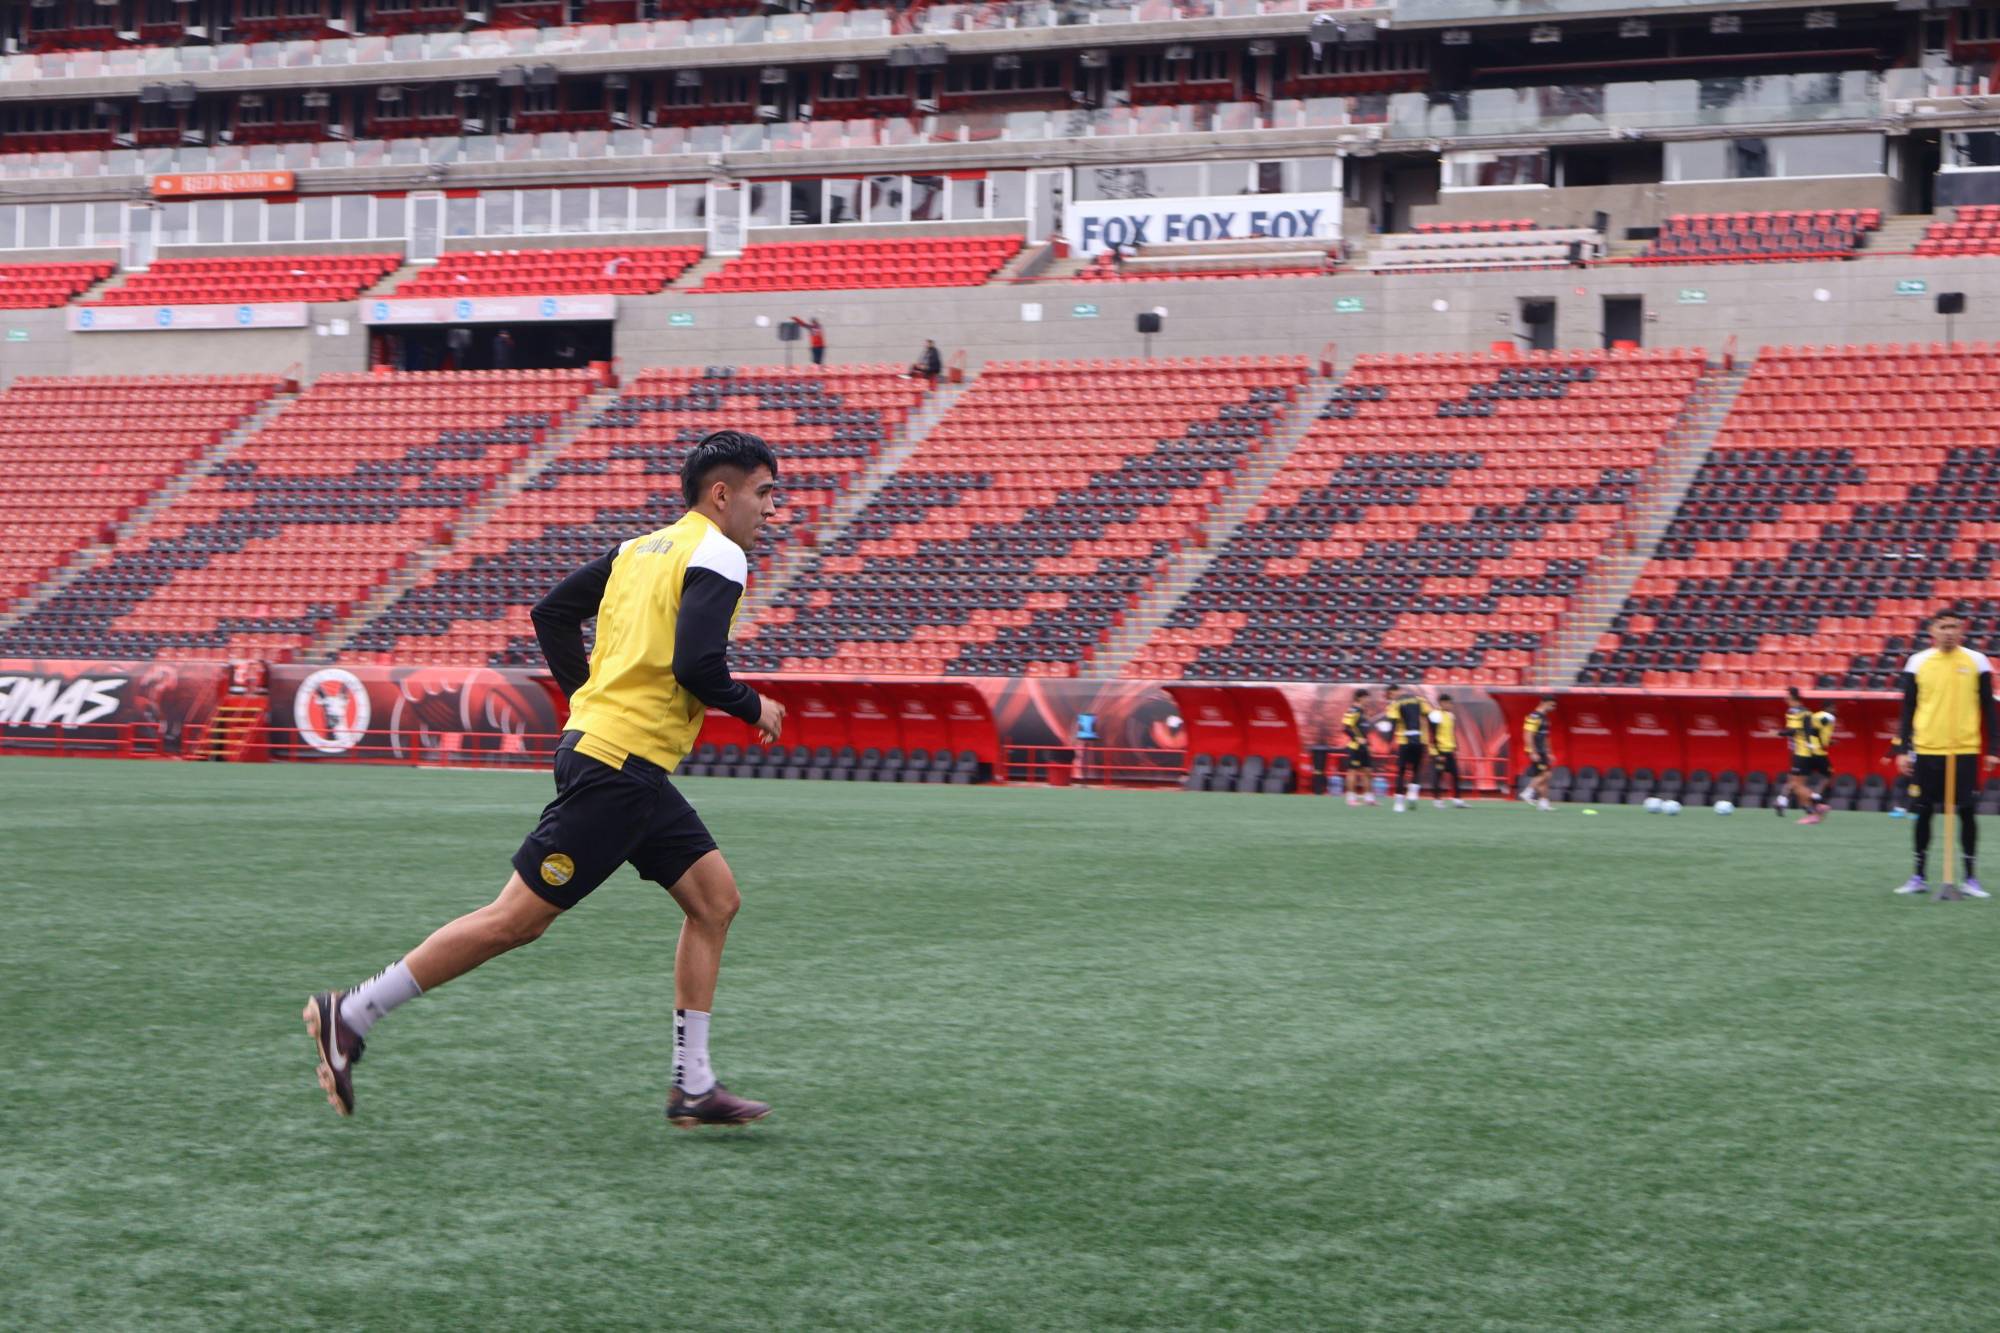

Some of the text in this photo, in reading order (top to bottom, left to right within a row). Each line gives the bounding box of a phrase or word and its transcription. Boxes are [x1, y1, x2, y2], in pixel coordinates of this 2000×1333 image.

[1082, 209, 1323, 251] FOX FOX FOX
